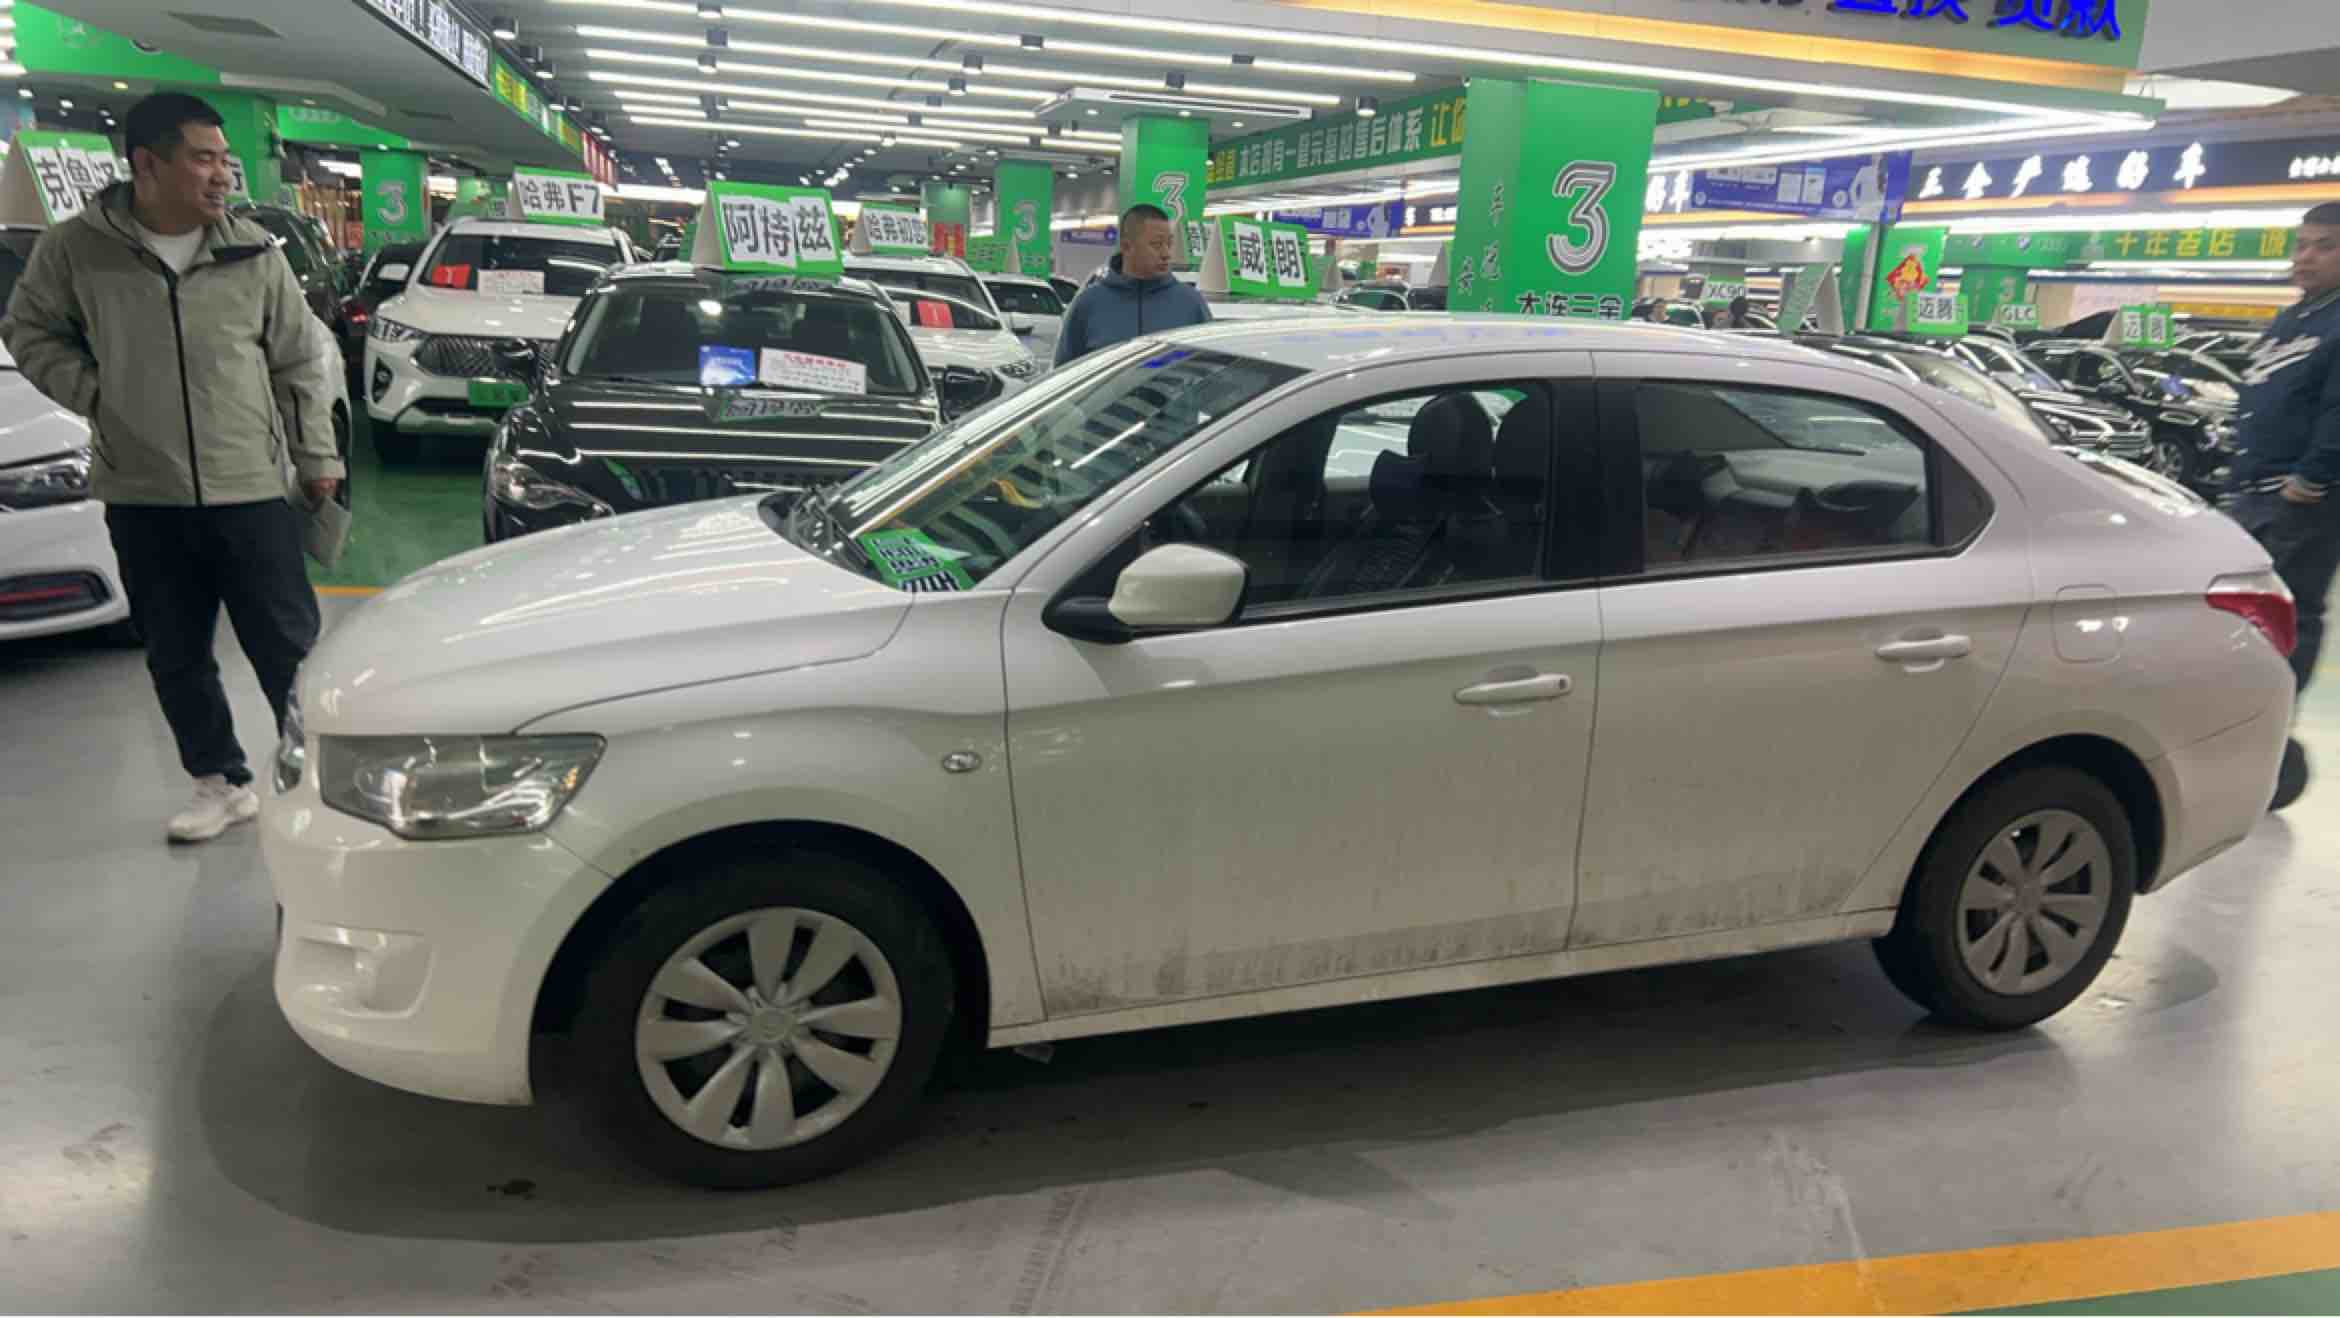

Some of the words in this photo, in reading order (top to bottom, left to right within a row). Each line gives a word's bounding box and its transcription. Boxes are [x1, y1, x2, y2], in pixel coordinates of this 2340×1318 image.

[376, 178, 408, 225] 3
[1012, 201, 1037, 241] 3
[1546, 160, 1616, 276] 3
[722, 202, 832, 257] 阿特兹
[1238, 232, 1301, 279] 威朗
